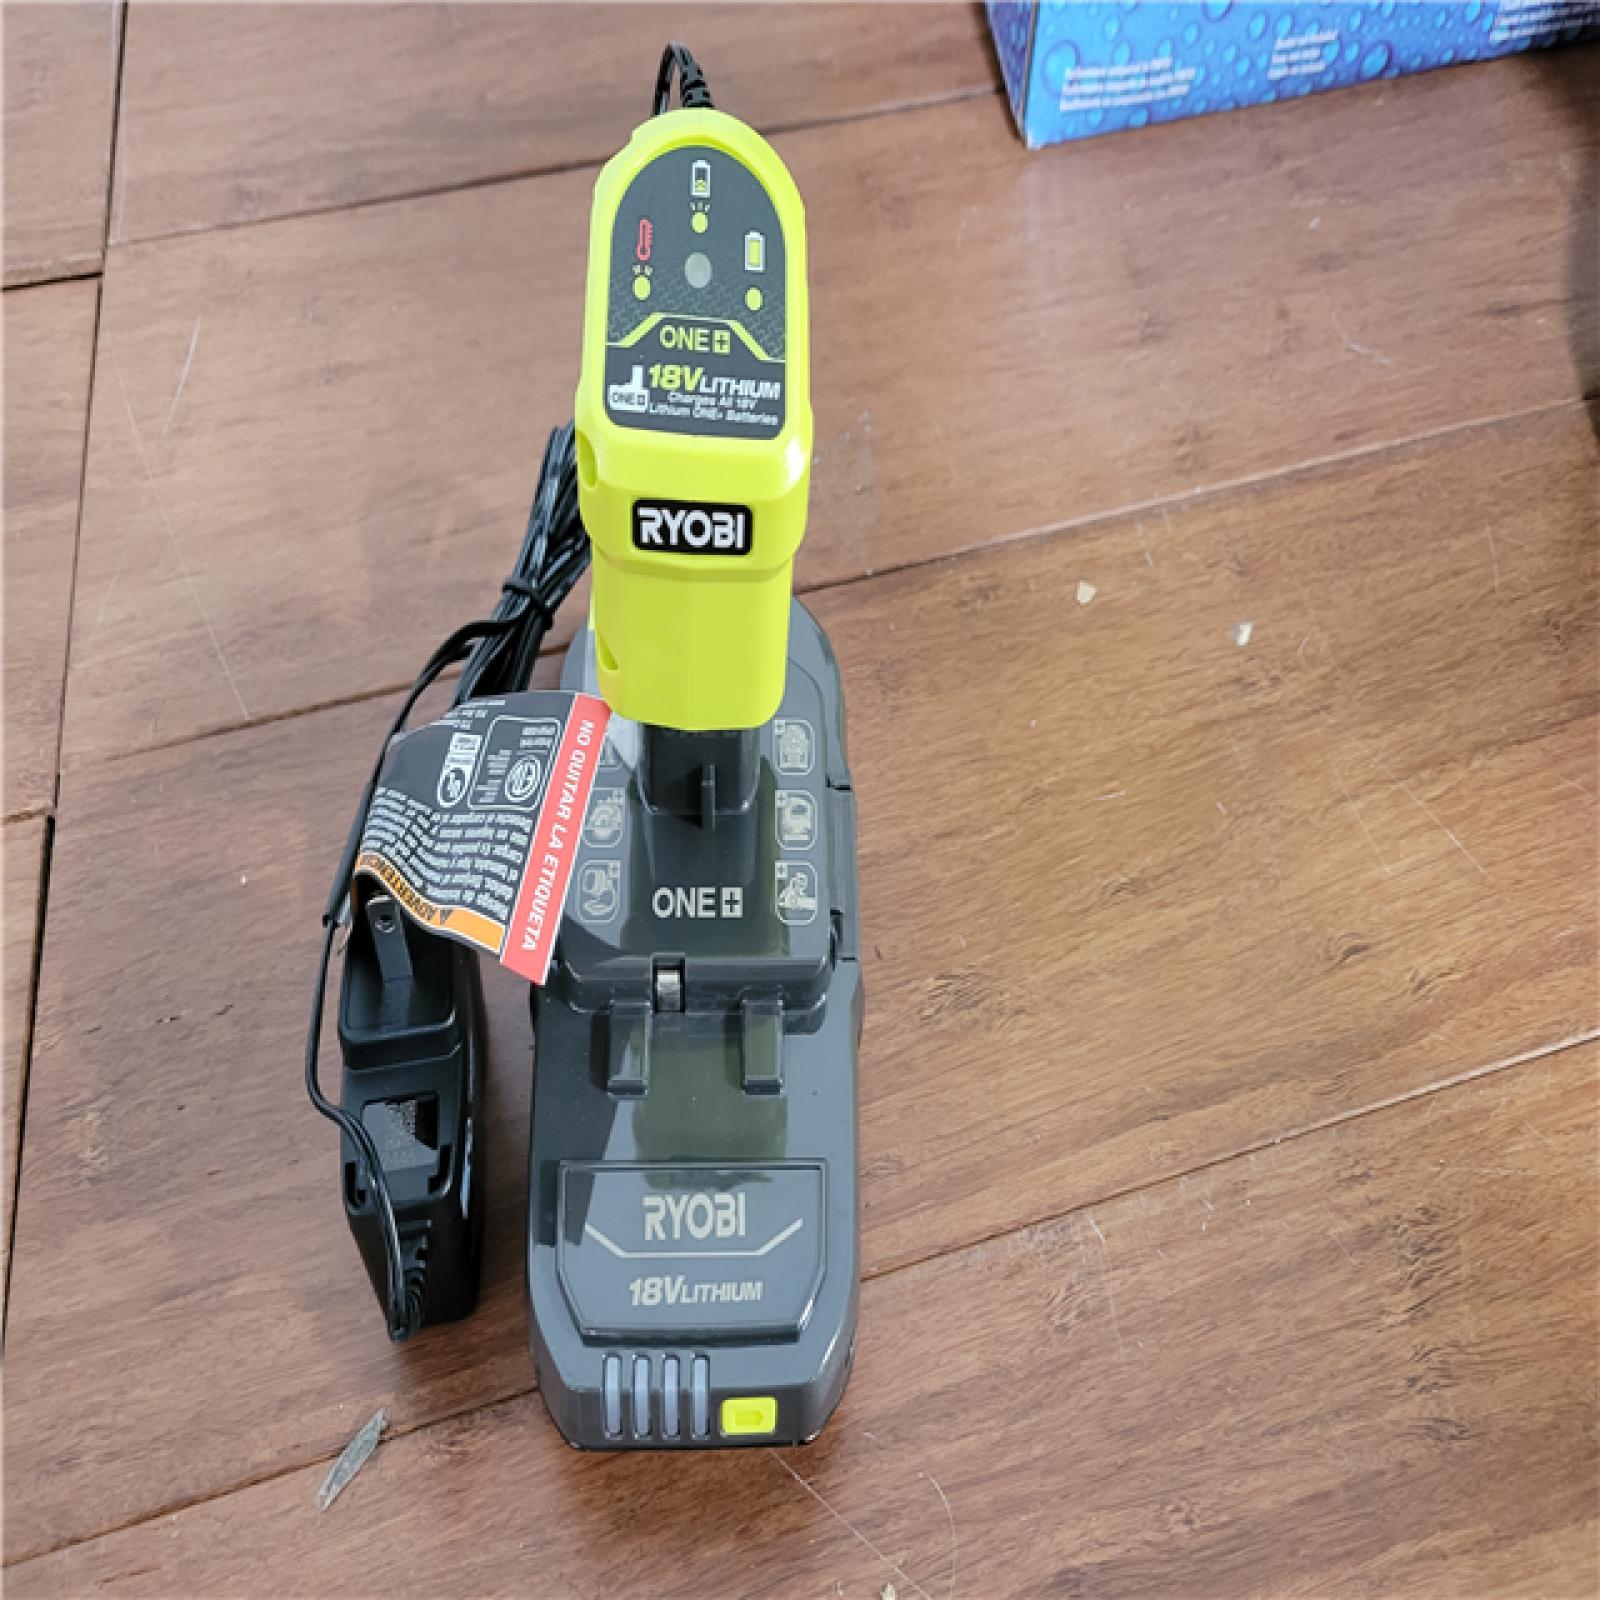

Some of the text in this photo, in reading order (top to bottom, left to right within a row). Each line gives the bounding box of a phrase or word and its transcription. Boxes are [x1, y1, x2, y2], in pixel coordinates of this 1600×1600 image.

[700, 375, 781, 400] LITHIUM
[637, 506, 746, 549] RYOBI
[521, 719, 596, 951] NO QUITAR LA ETIQUETA
[642, 1192, 746, 1241] RYOBI
[629, 1275, 763, 1306] 18V LITHIUM
